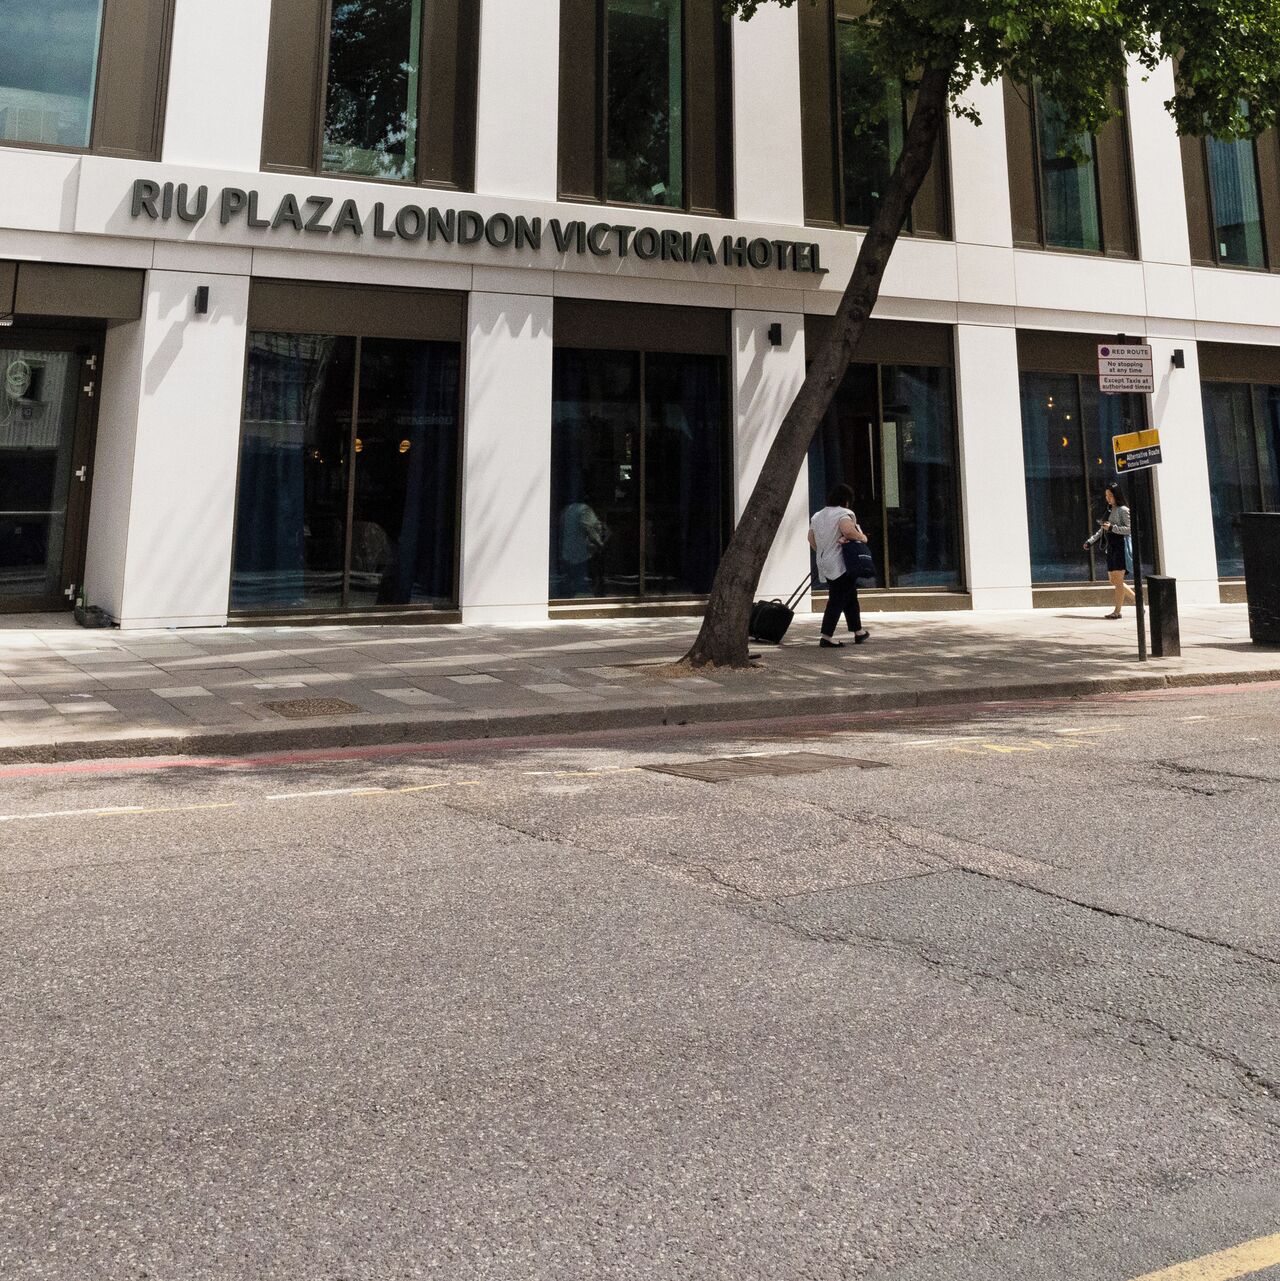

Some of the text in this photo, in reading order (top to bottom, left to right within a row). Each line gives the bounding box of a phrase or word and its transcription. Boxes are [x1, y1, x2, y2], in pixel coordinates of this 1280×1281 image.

[131, 179, 830, 274] RIU PLAZA LONDON VICTORIA HOTEL
